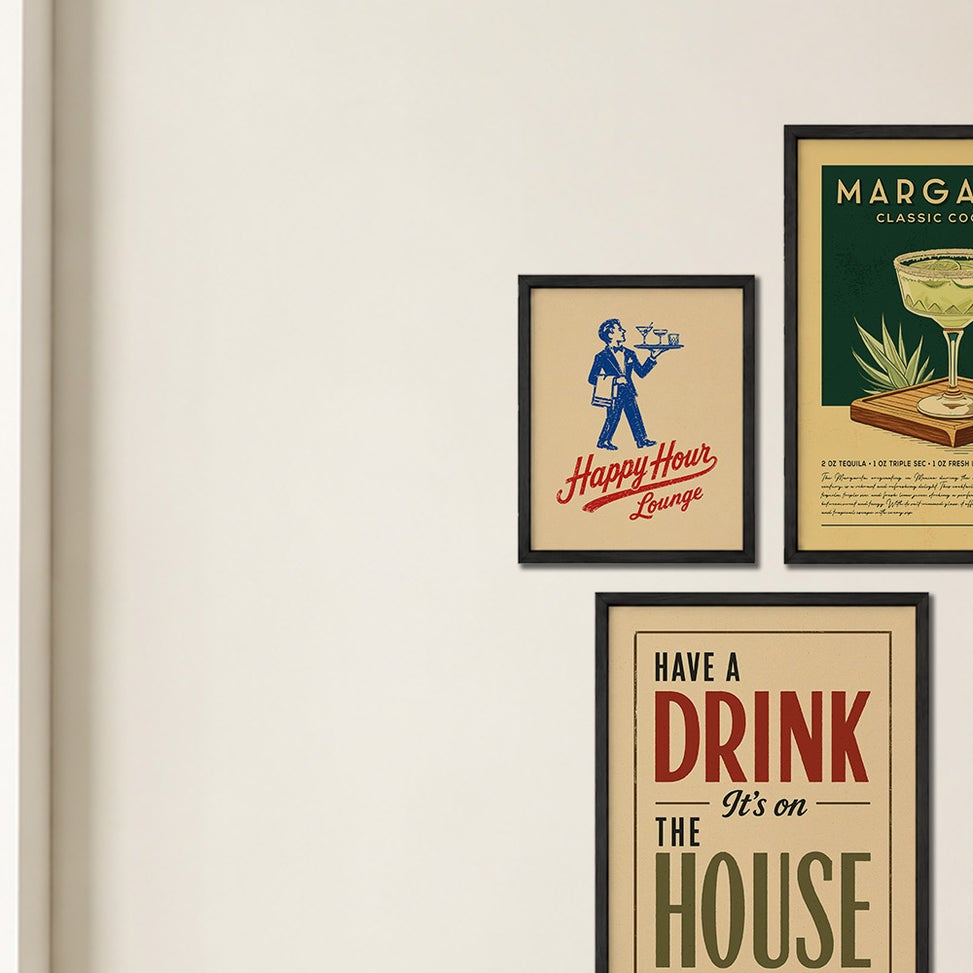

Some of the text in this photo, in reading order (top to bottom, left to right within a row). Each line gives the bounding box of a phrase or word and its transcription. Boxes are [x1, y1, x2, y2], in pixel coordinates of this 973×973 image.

[876, 213, 942, 223] CLASSIC
[556, 440, 718, 504] Happy Hour
[629, 486, 704, 520] Lounge
[655, 652, 741, 682] HAVE A
[655, 691, 871, 782] DRINK
[721, 789, 808, 818] It's on
[655, 817, 700, 847] THE
[655, 851, 871, 969] HOUSE
